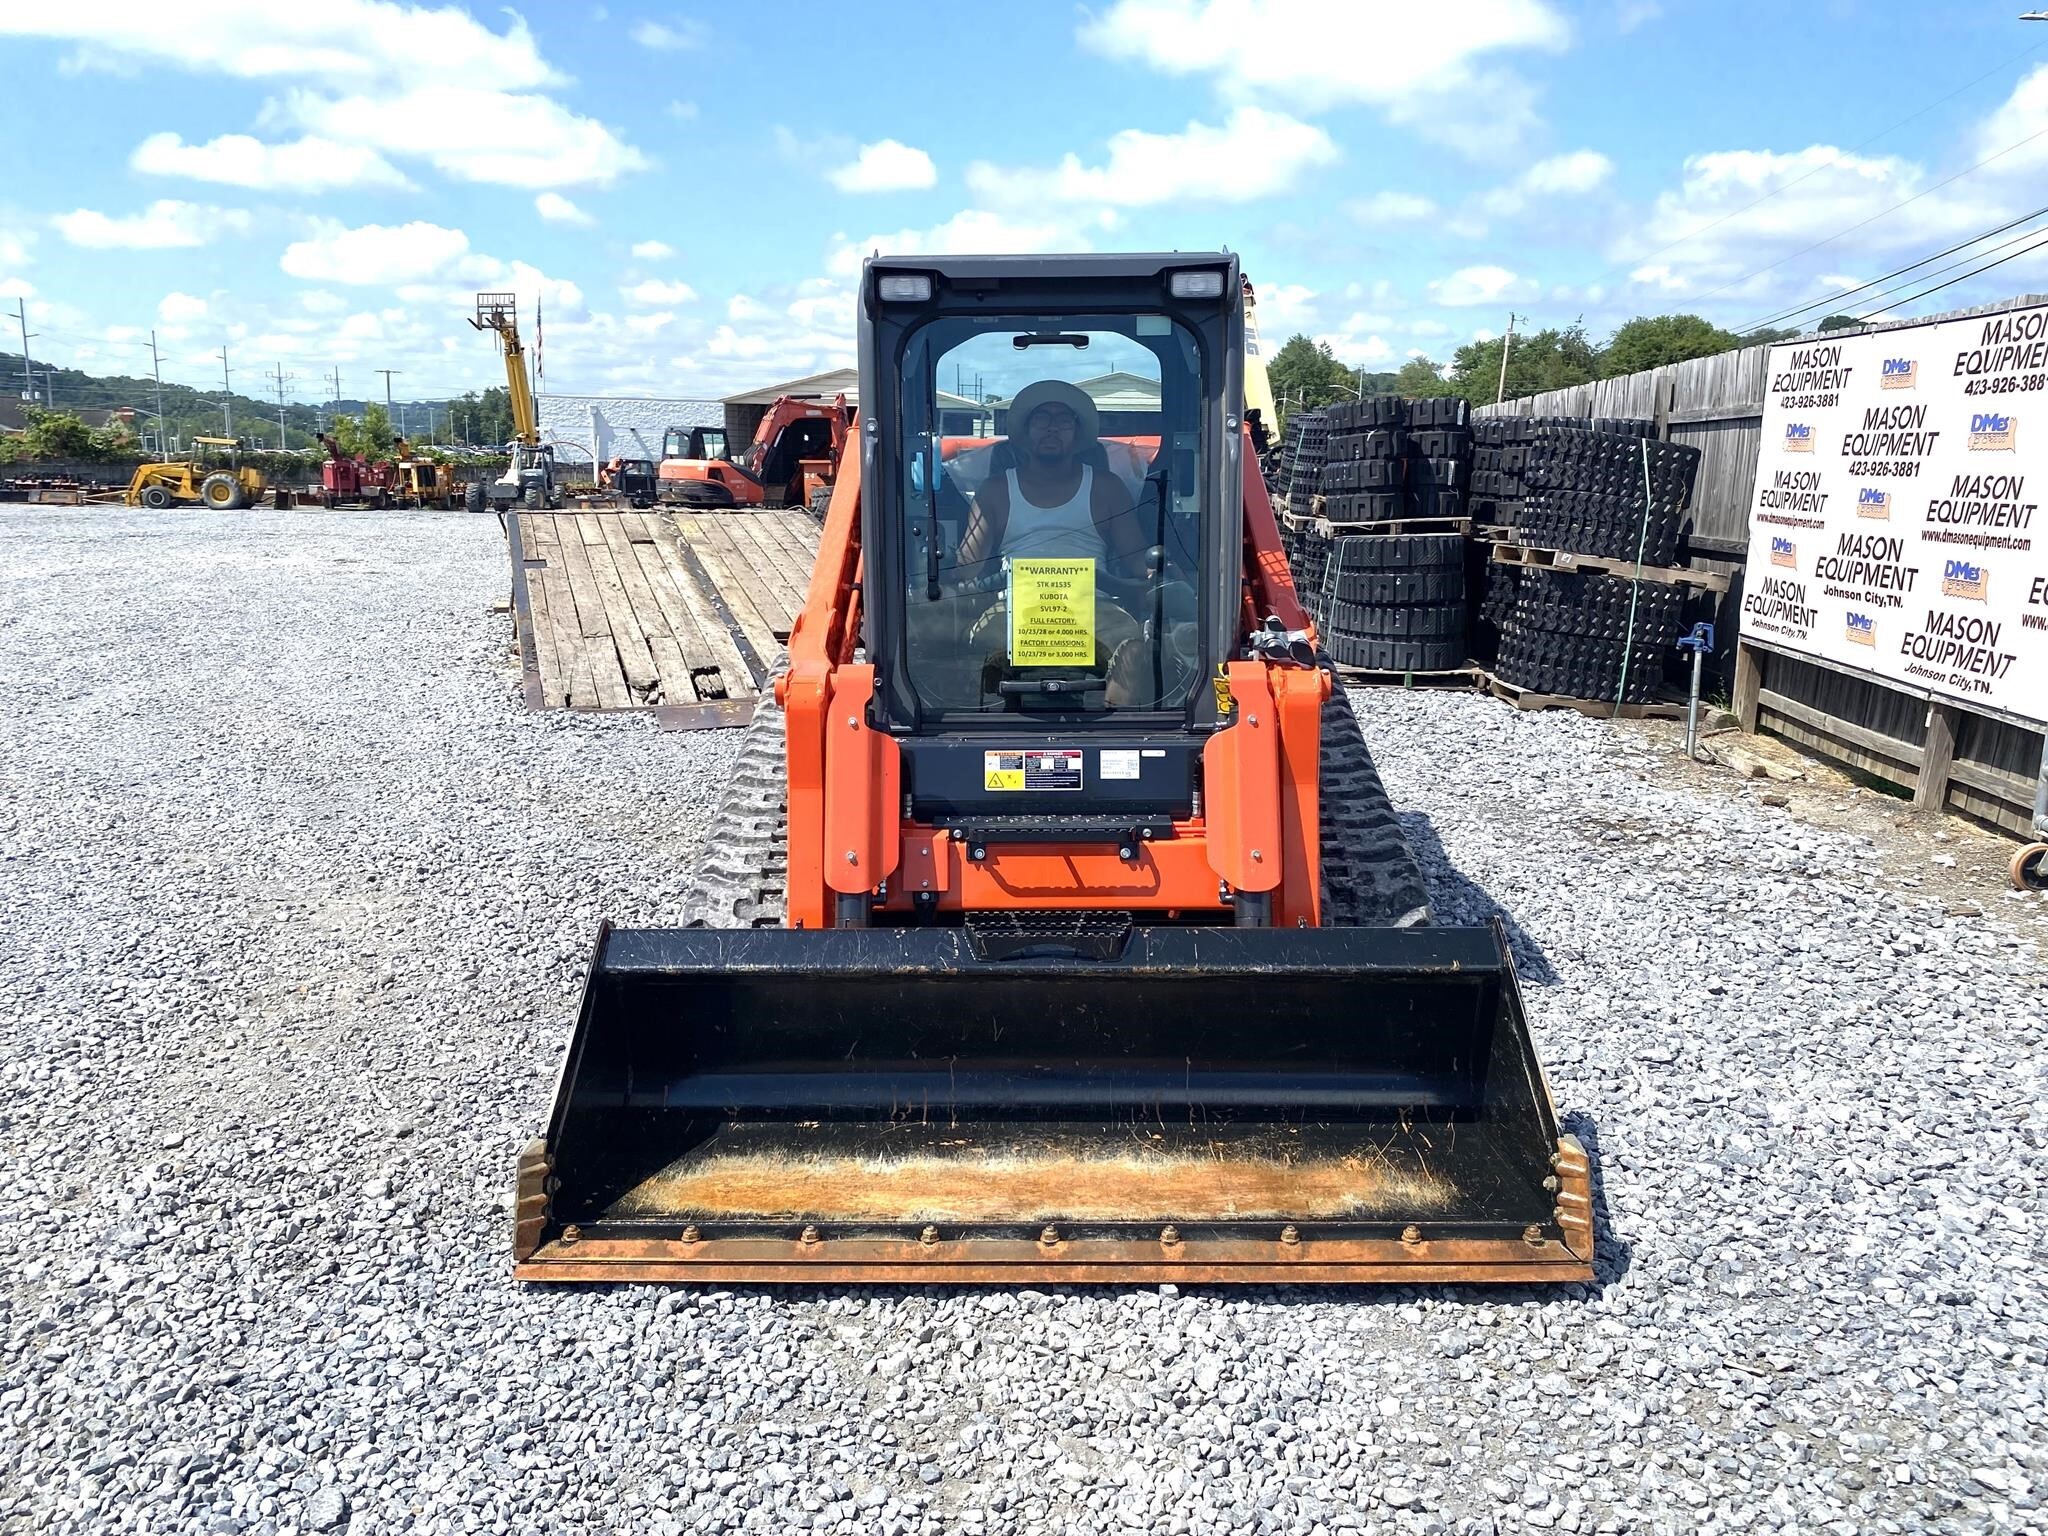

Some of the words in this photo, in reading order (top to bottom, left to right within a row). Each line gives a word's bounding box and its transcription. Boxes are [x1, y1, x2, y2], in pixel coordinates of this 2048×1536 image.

[1790, 346, 1841, 370] MASON
[1772, 368, 1853, 392] EQUIPMENT
[1964, 373, 2048, 396] 423-926-388
[1781, 393, 1839, 409] 423-926-3881
[1863, 404, 1927, 430] MASON
[1841, 432, 1940, 456] EQUIPMENT
[1773, 470, 1821, 491] MASON
[1849, 461, 1920, 477] 423-926-3881
[1950, 475, 2024, 500] MASON
[1760, 489, 1828, 512] EQUIPMENT
[1757, 512, 1825, 530] www.dmasonequipment.com
[1926, 500, 2038, 529] EQUIPMENT
[1837, 533, 1904, 562] MASON
[1921, 528, 2031, 551] www.dmasonequipment.com
[1815, 556, 1919, 592] EQUIPMENT
[1761, 576, 1806, 604] MASON
[1823, 584, 1861, 601] Johnson
[1040, 605, 1068, 613] SVL97-2
[1744, 594, 1818, 629] EQUIPMENT
[1751, 617, 1779, 633] Johnson
[1925, 610, 2002, 647] MASON
[1020, 639, 1048, 647] FACTORY
[1900, 632, 2017, 679] EQUIPMENT
[1904, 662, 1946, 682] Johnson
